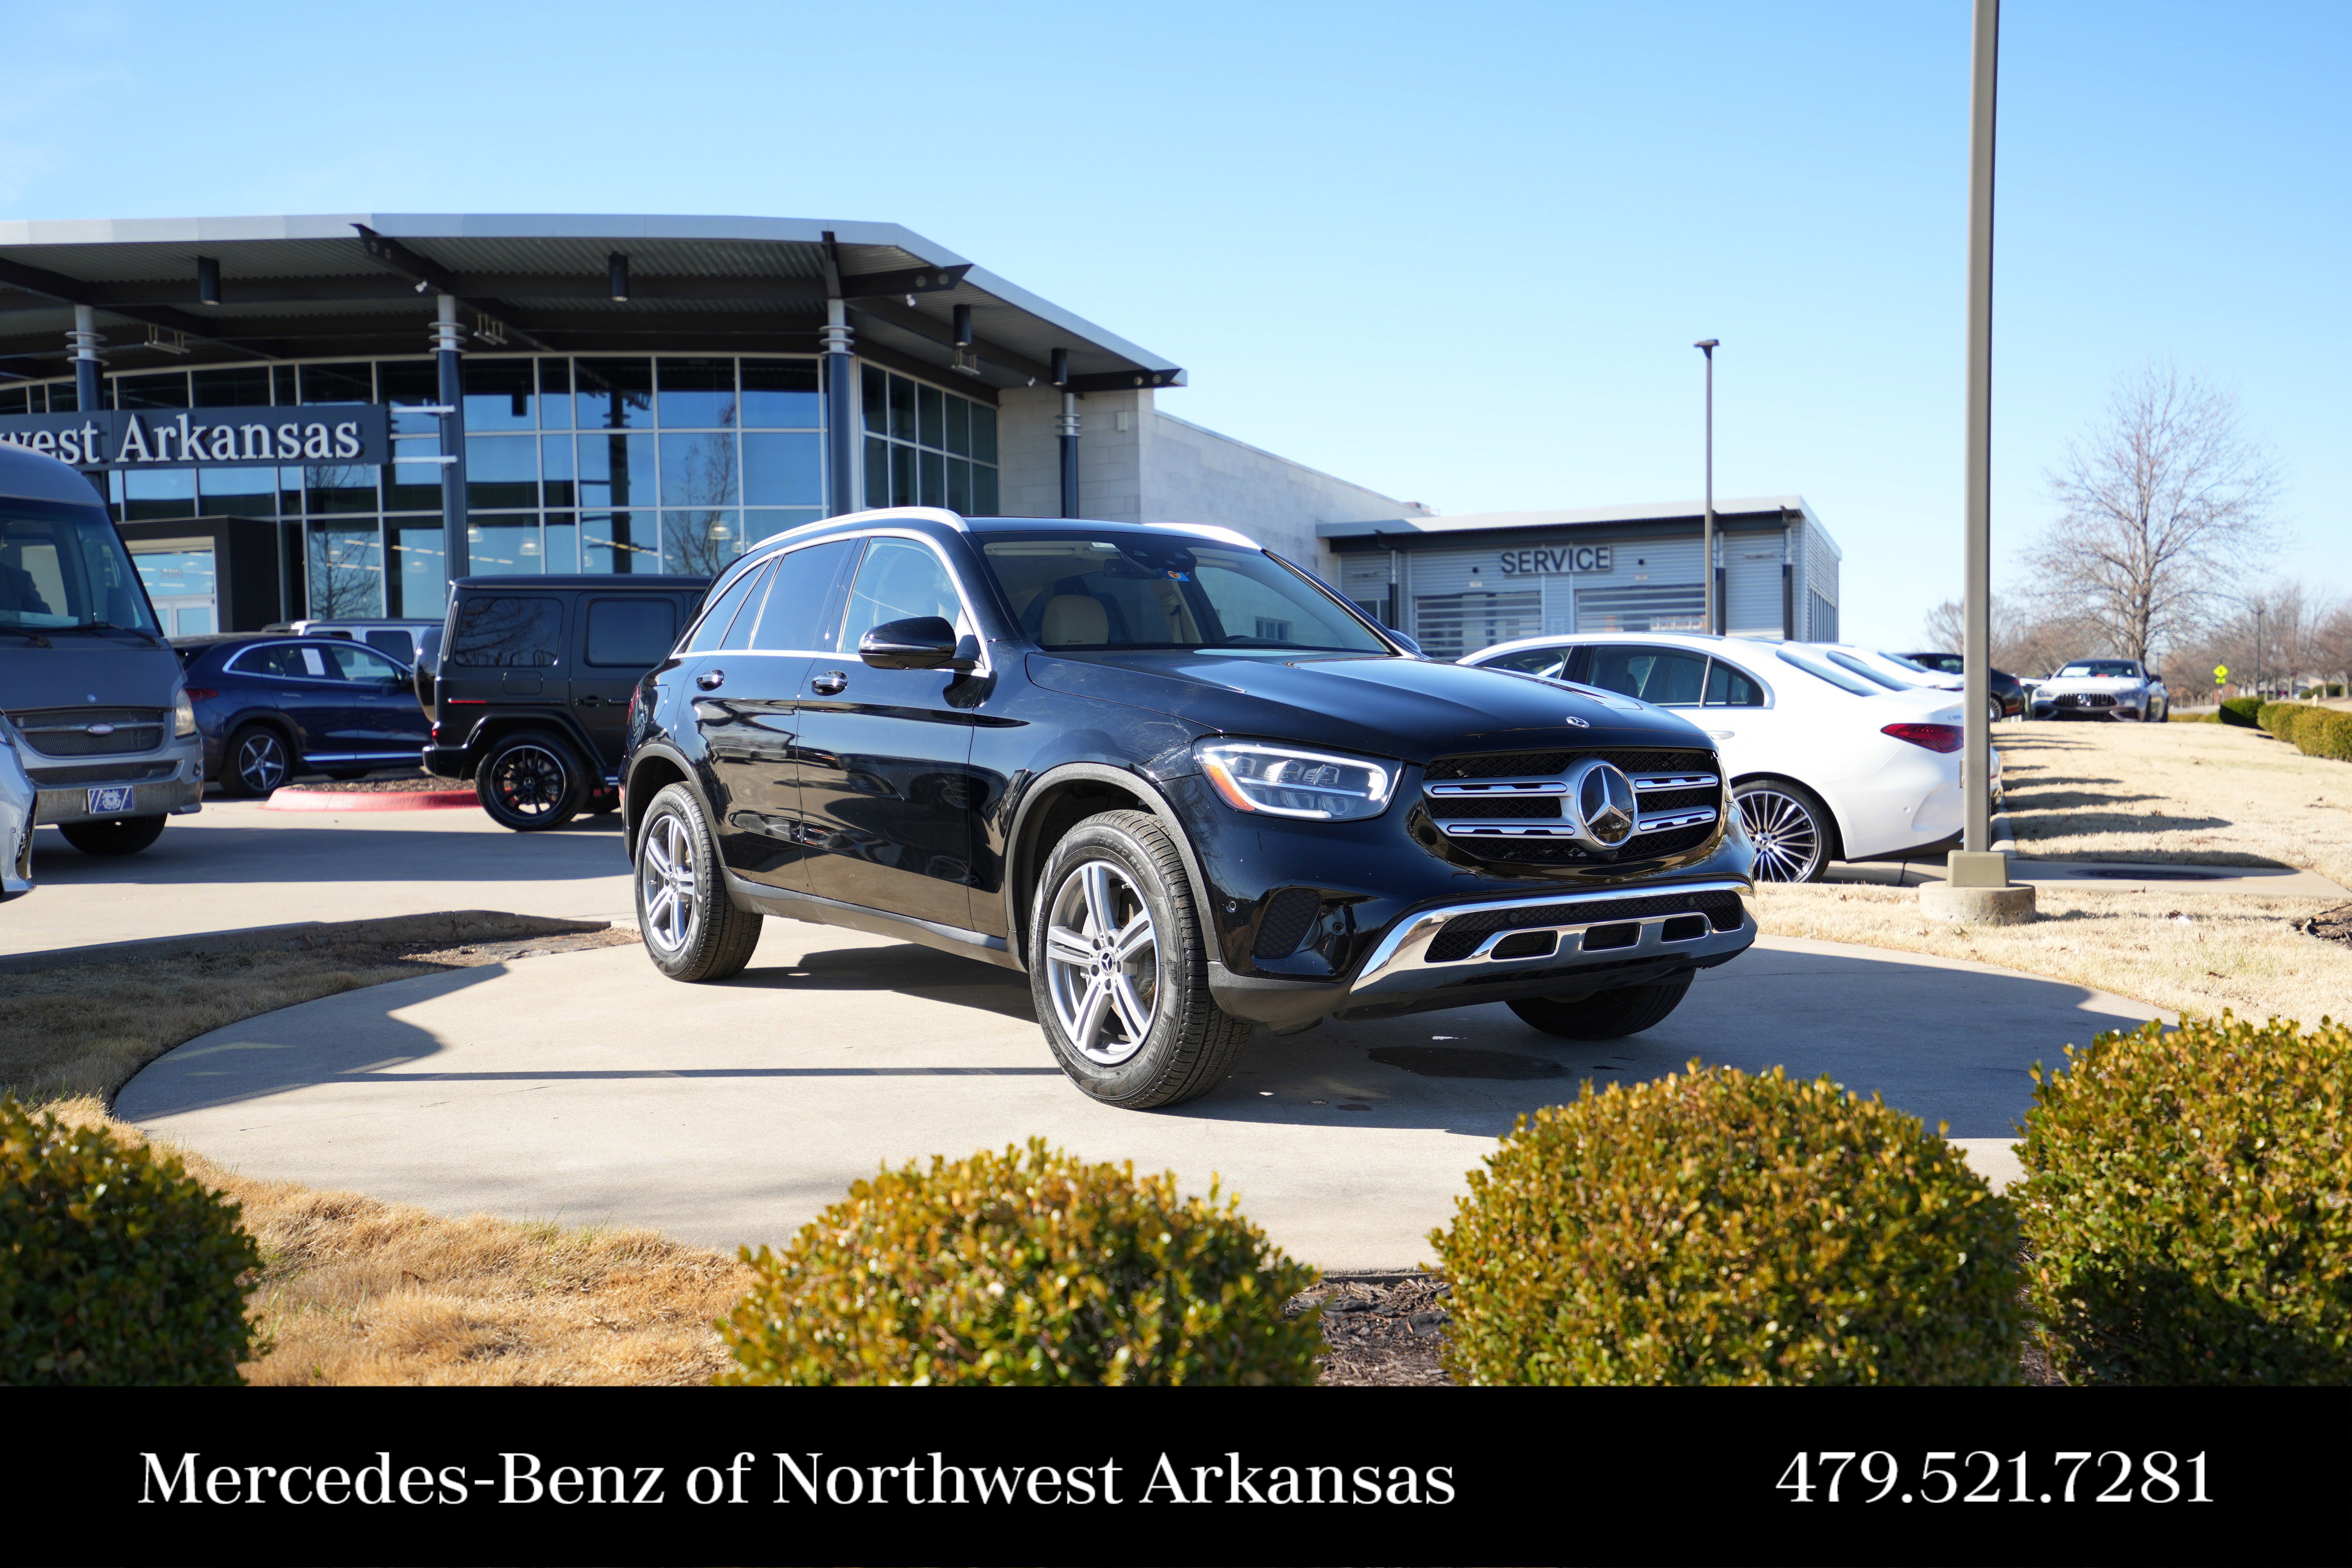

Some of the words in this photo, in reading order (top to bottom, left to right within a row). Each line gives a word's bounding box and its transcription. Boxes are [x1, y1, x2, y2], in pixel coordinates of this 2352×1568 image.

[115, 412, 360, 463] Arkansas
[1500, 546, 1610, 573] SERVICE
[1093, 835, 1129, 856] 235/60
[1128, 855, 1146, 877] R18
[1146, 1010, 1174, 1066] PIRELLI
